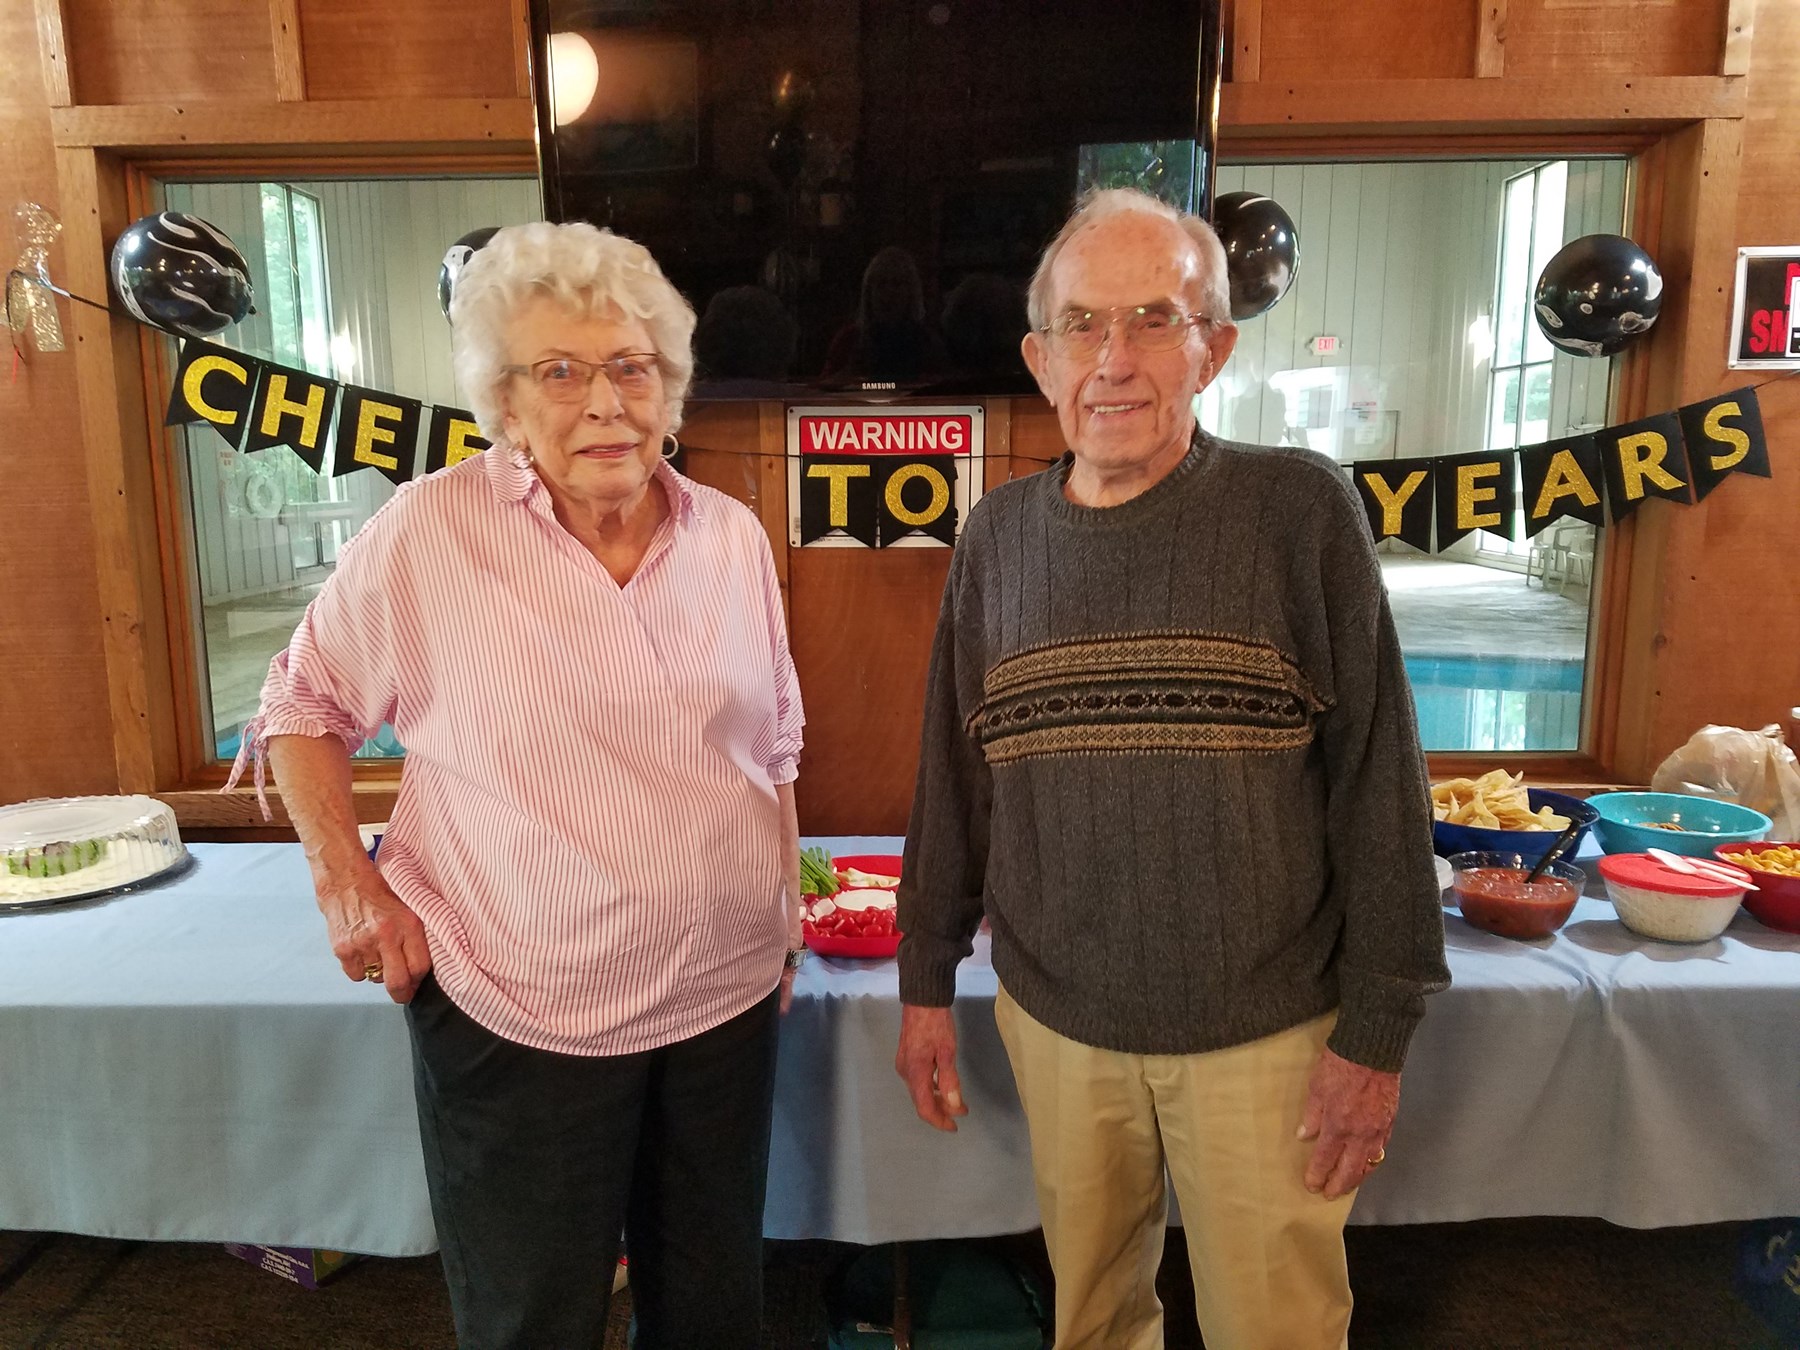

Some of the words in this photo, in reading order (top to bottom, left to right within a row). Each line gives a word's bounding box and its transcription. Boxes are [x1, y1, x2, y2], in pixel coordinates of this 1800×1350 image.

[1318, 338, 1335, 351] EXIT
[862, 382, 896, 390] SAMSUNG
[809, 421, 963, 449] WARNING
[1364, 401, 1751, 536] YEARS
[807, 463, 950, 526] TO
